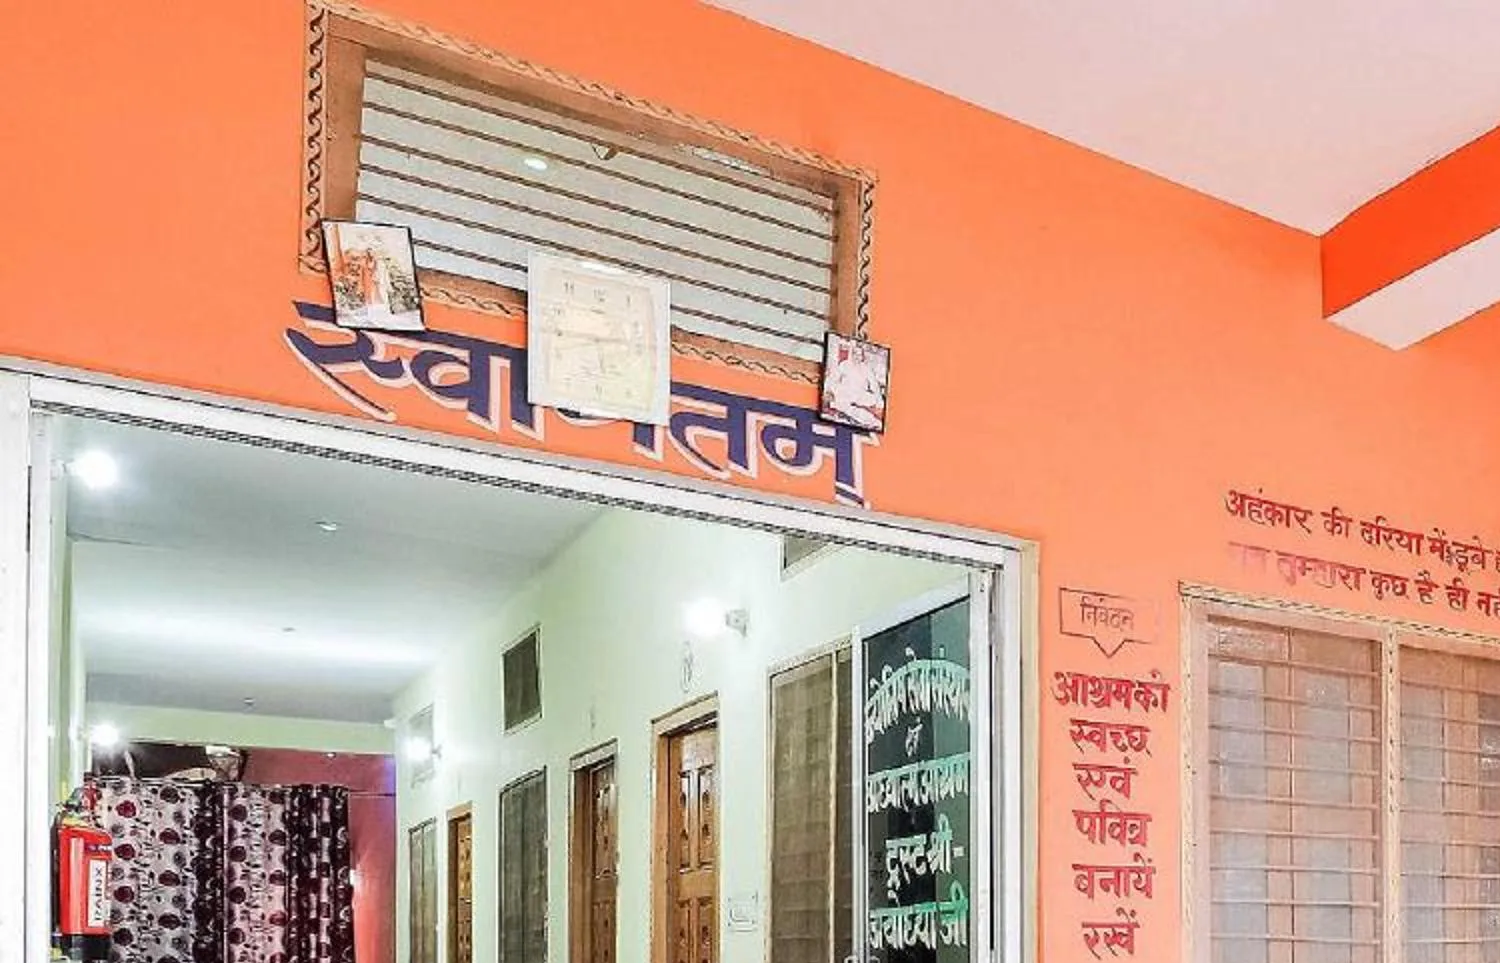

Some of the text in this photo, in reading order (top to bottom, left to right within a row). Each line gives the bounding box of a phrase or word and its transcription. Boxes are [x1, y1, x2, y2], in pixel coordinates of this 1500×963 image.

[1225, 488, 1314, 535] अहंकार
[1320, 505, 1354, 539] की
[1369, 569, 1410, 601] कुछ
[1415, 569, 1440, 605] है
[1444, 576, 1471, 612] ही
[1068, 718, 1152, 758] स्वच्छ
[1072, 799, 1153, 847] पवित्र
[1072, 853, 1157, 900] बनायें
